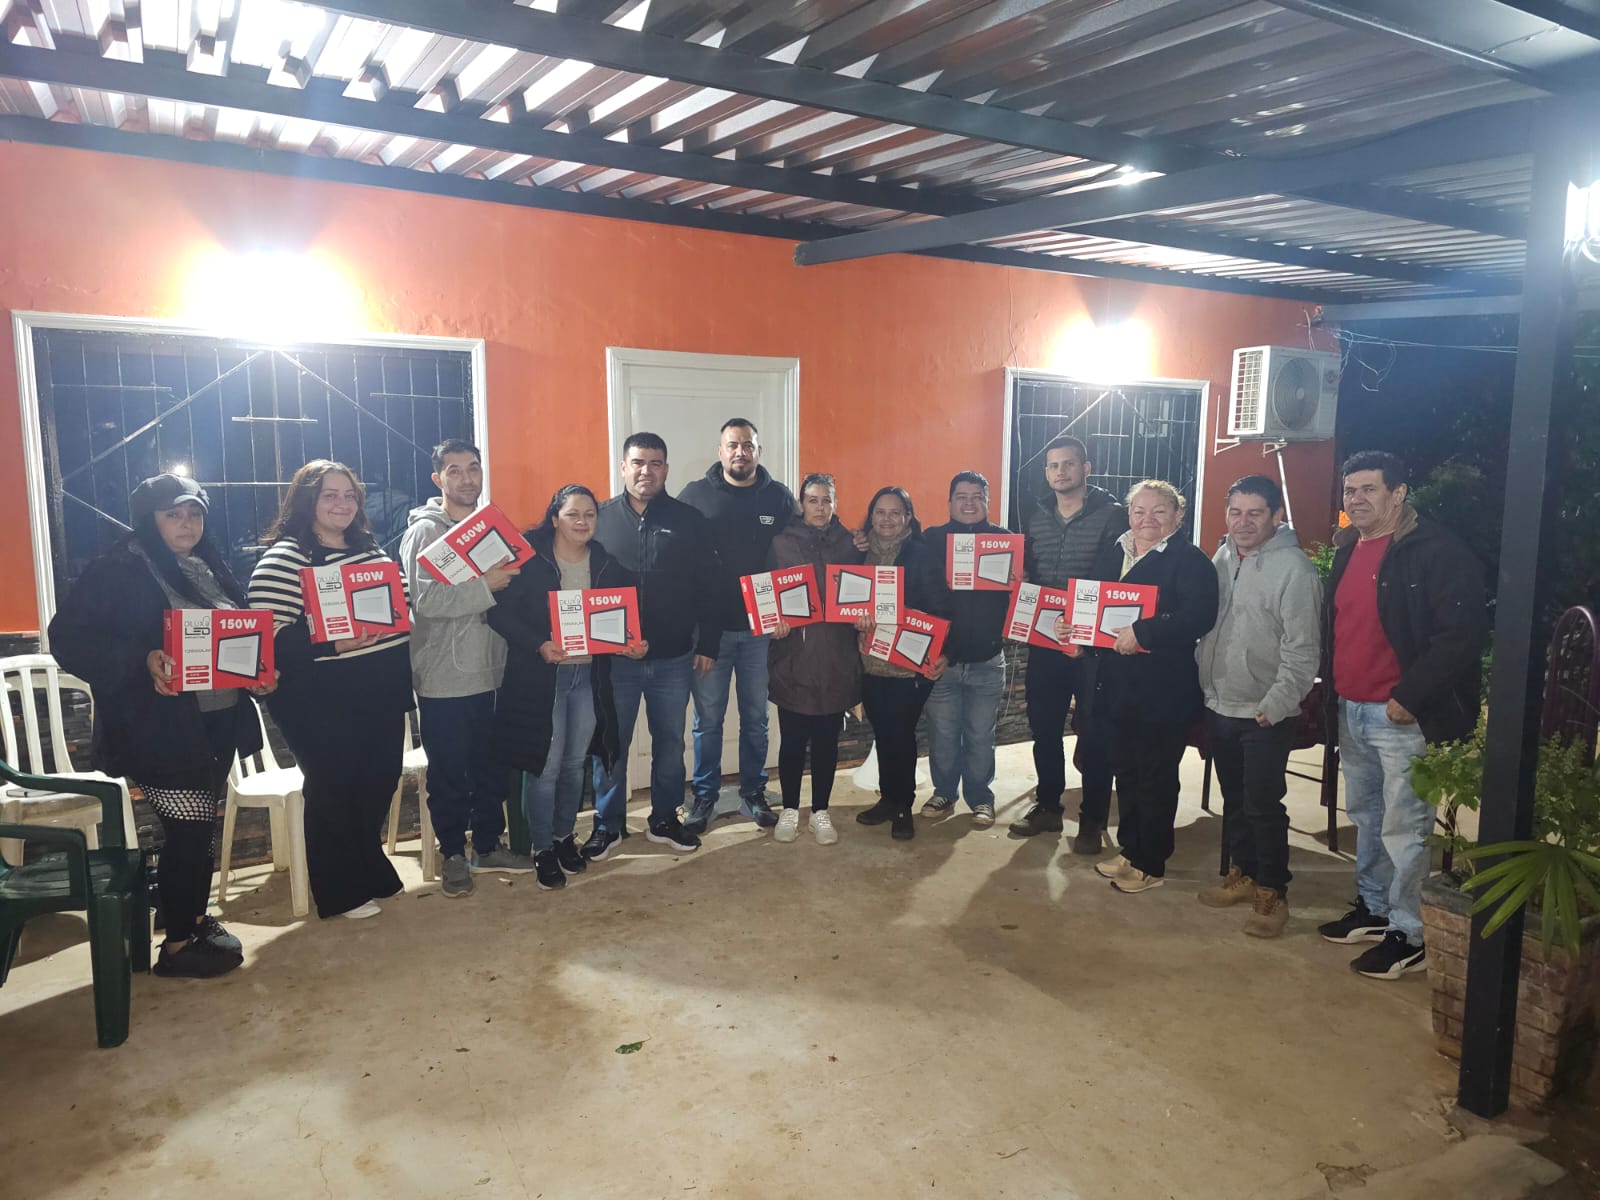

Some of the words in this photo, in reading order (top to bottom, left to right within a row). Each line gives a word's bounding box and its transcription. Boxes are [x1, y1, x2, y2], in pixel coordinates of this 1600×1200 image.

[455, 520, 487, 546] 150W
[980, 540, 1011, 549] 150W
[348, 570, 384, 583] 150W
[777, 572, 803, 585] 150W
[318, 581, 342, 591] LED
[589, 594, 622, 606] 150W
[1105, 589, 1140, 602] 150W
[560, 604, 582, 612] LED
[840, 607, 869, 617] 150W
[219, 618, 257, 630] 150W
[905, 615, 934, 632] 150W
[184, 627, 211, 636] LED
